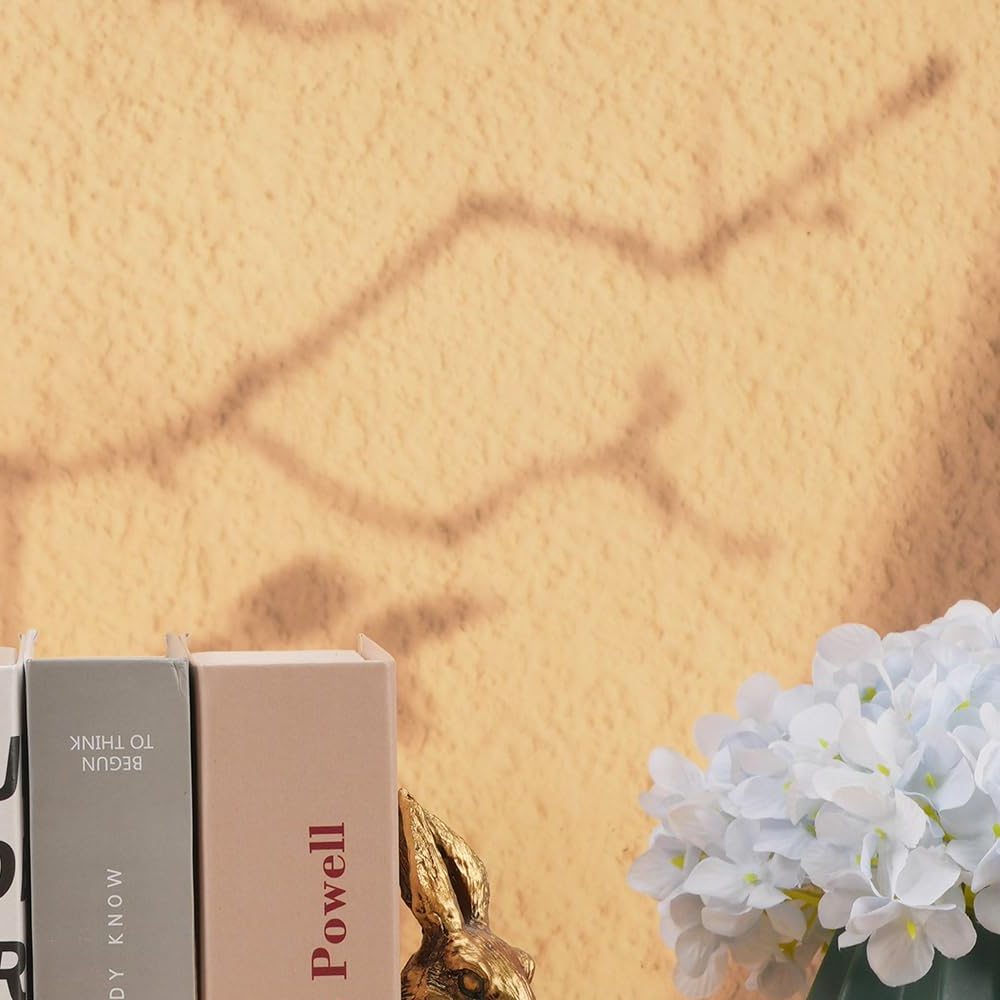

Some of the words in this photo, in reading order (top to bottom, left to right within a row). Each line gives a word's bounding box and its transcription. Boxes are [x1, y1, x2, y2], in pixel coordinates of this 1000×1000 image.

[69, 735, 125, 751] THINK
[130, 734, 154, 750] TO
[82, 756, 143, 772] BEGUN
[106, 868, 124, 945] KNOW
[308, 822, 347, 981] Powell
